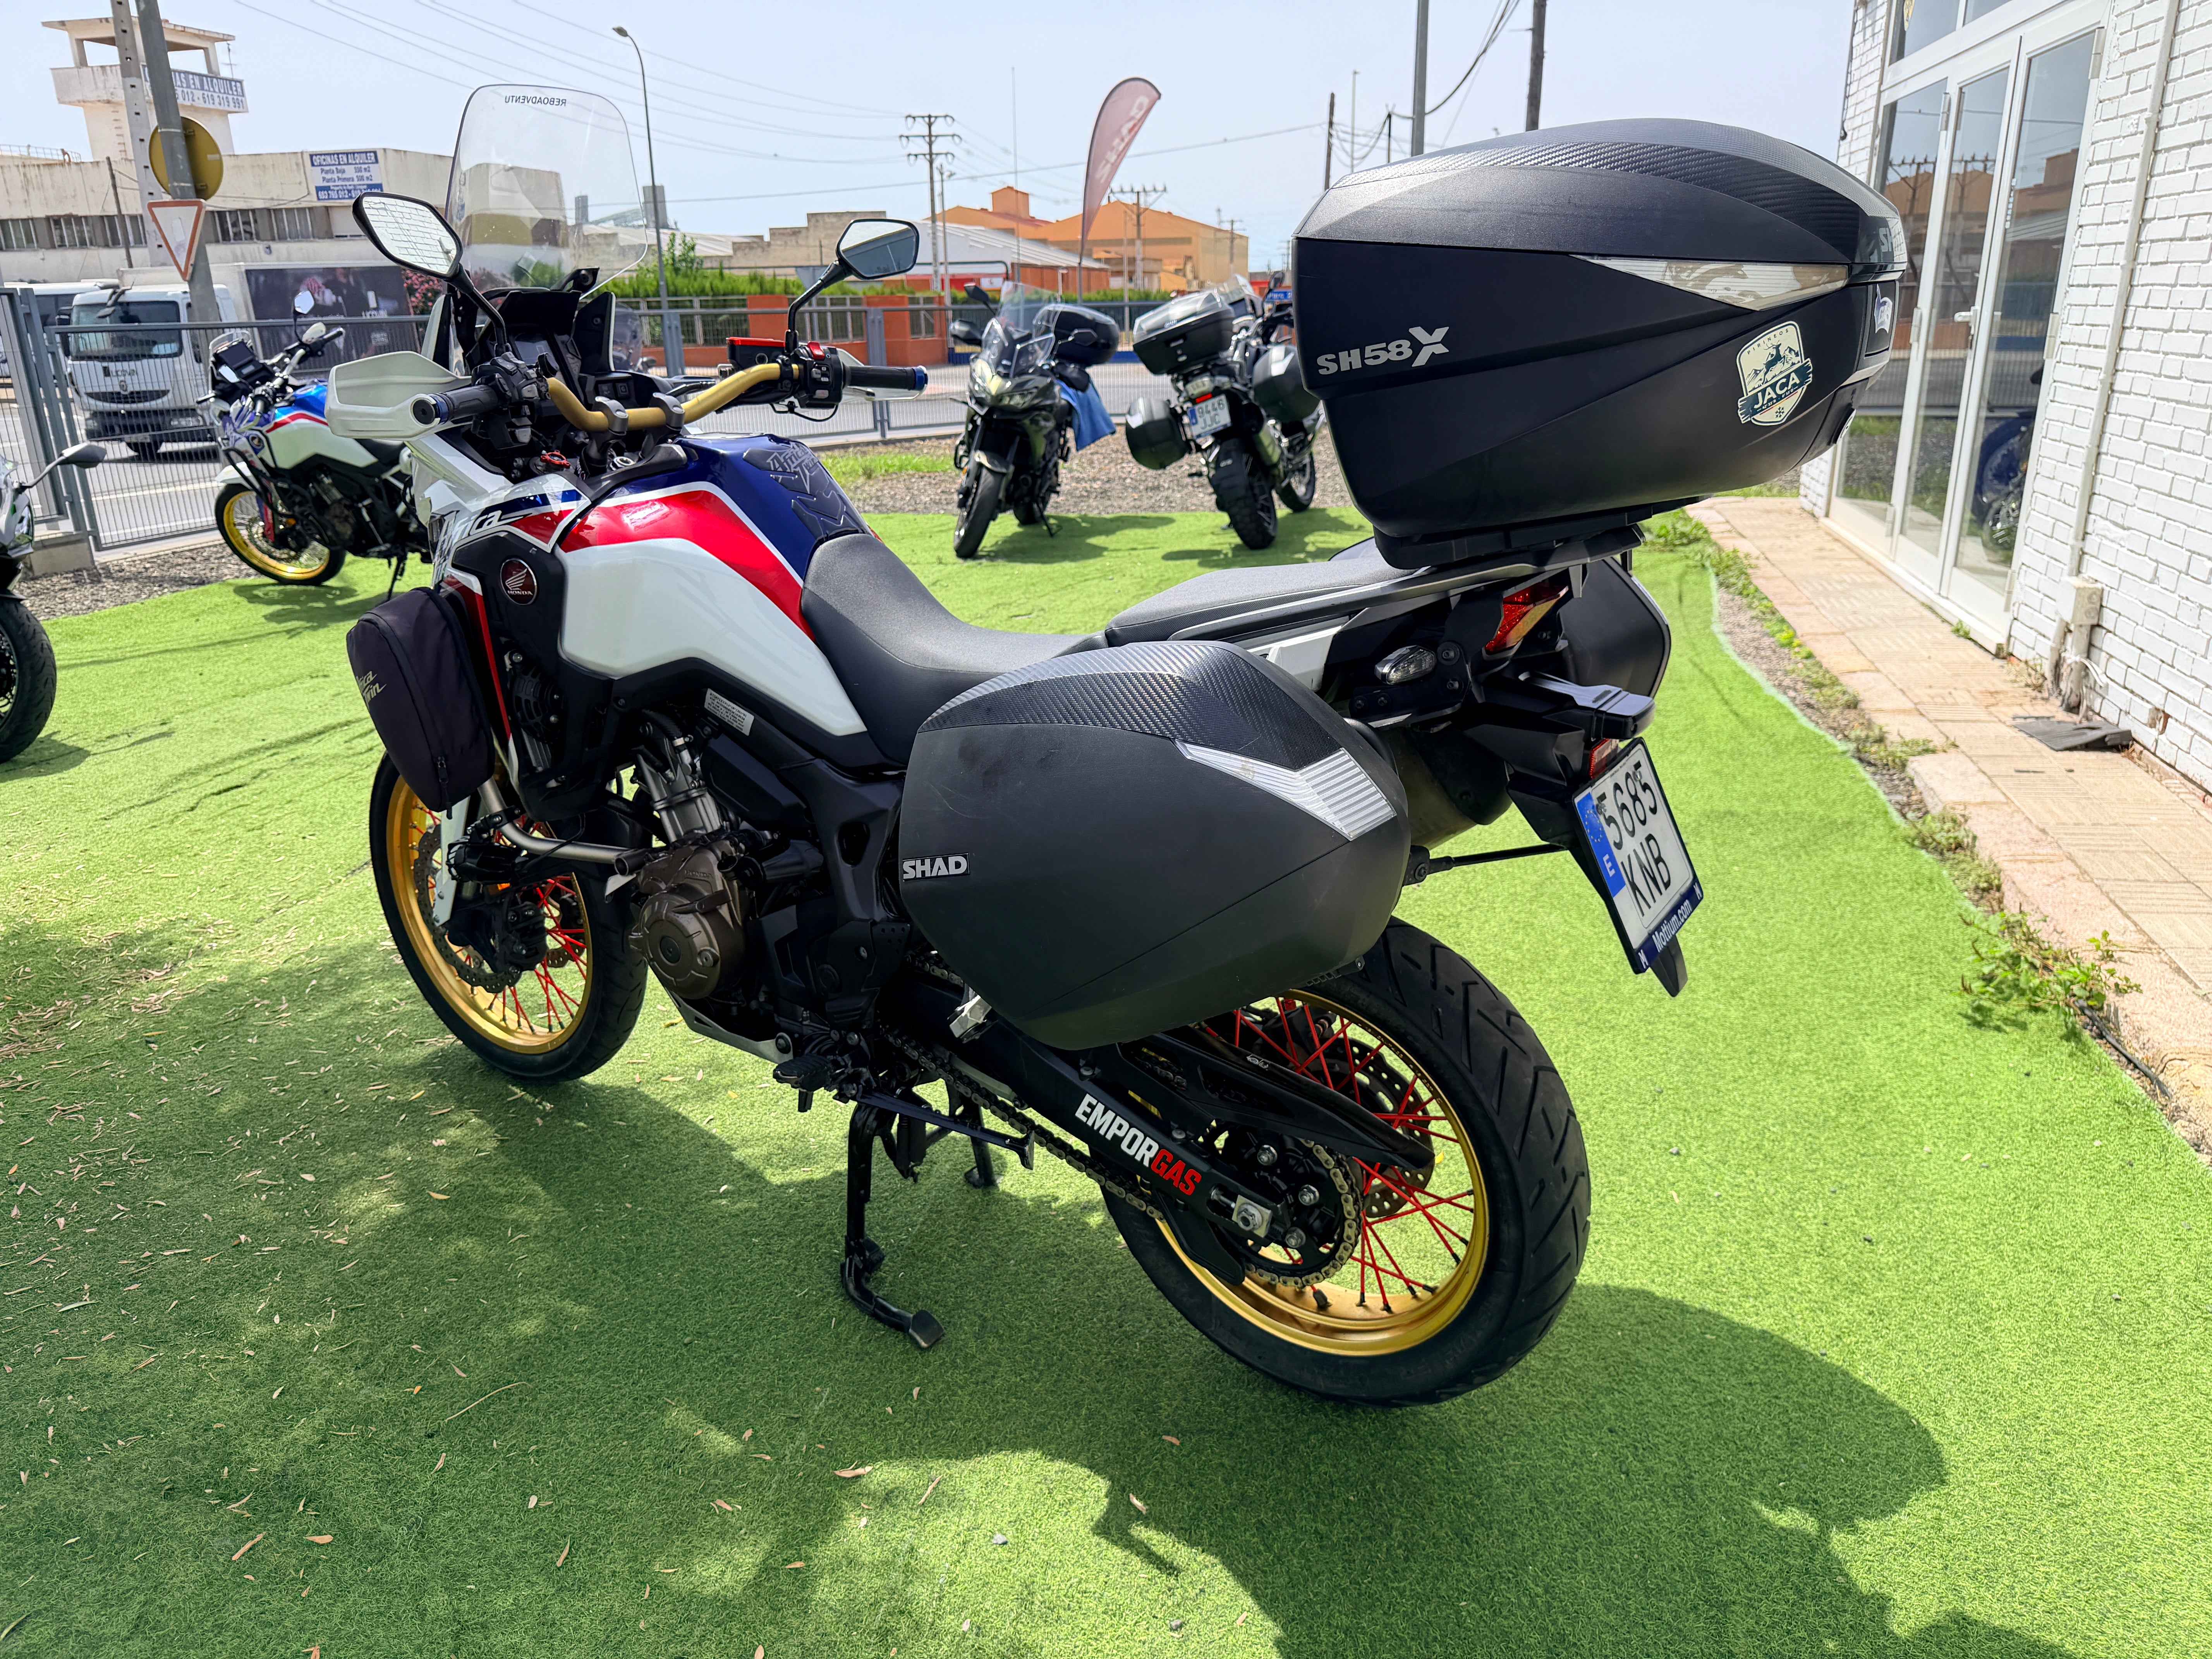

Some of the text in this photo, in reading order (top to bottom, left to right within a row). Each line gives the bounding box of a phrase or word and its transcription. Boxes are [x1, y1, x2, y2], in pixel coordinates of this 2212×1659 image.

[181, 89, 195, 102] 012
[202, 93, 215, 105] 619
[217, 95, 230, 107] 319
[189, 73, 201, 90] EN
[203, 77, 244, 96] ALQUILER
[1317, 326, 1449, 375] SH58X
[1747, 328, 1788, 355] PIRINEOS
[1753, 372, 1800, 409] JACA
[1197, 399, 1225, 418] 9446
[1596, 760, 1657, 850] 5685
[903, 856, 967, 879] SHAD
[1602, 854, 1615, 877] E
[1620, 833, 1671, 917] KNB
[1652, 899, 1693, 953] Mottium.com
[1075, 1094, 1202, 1195] EMPORGAS
